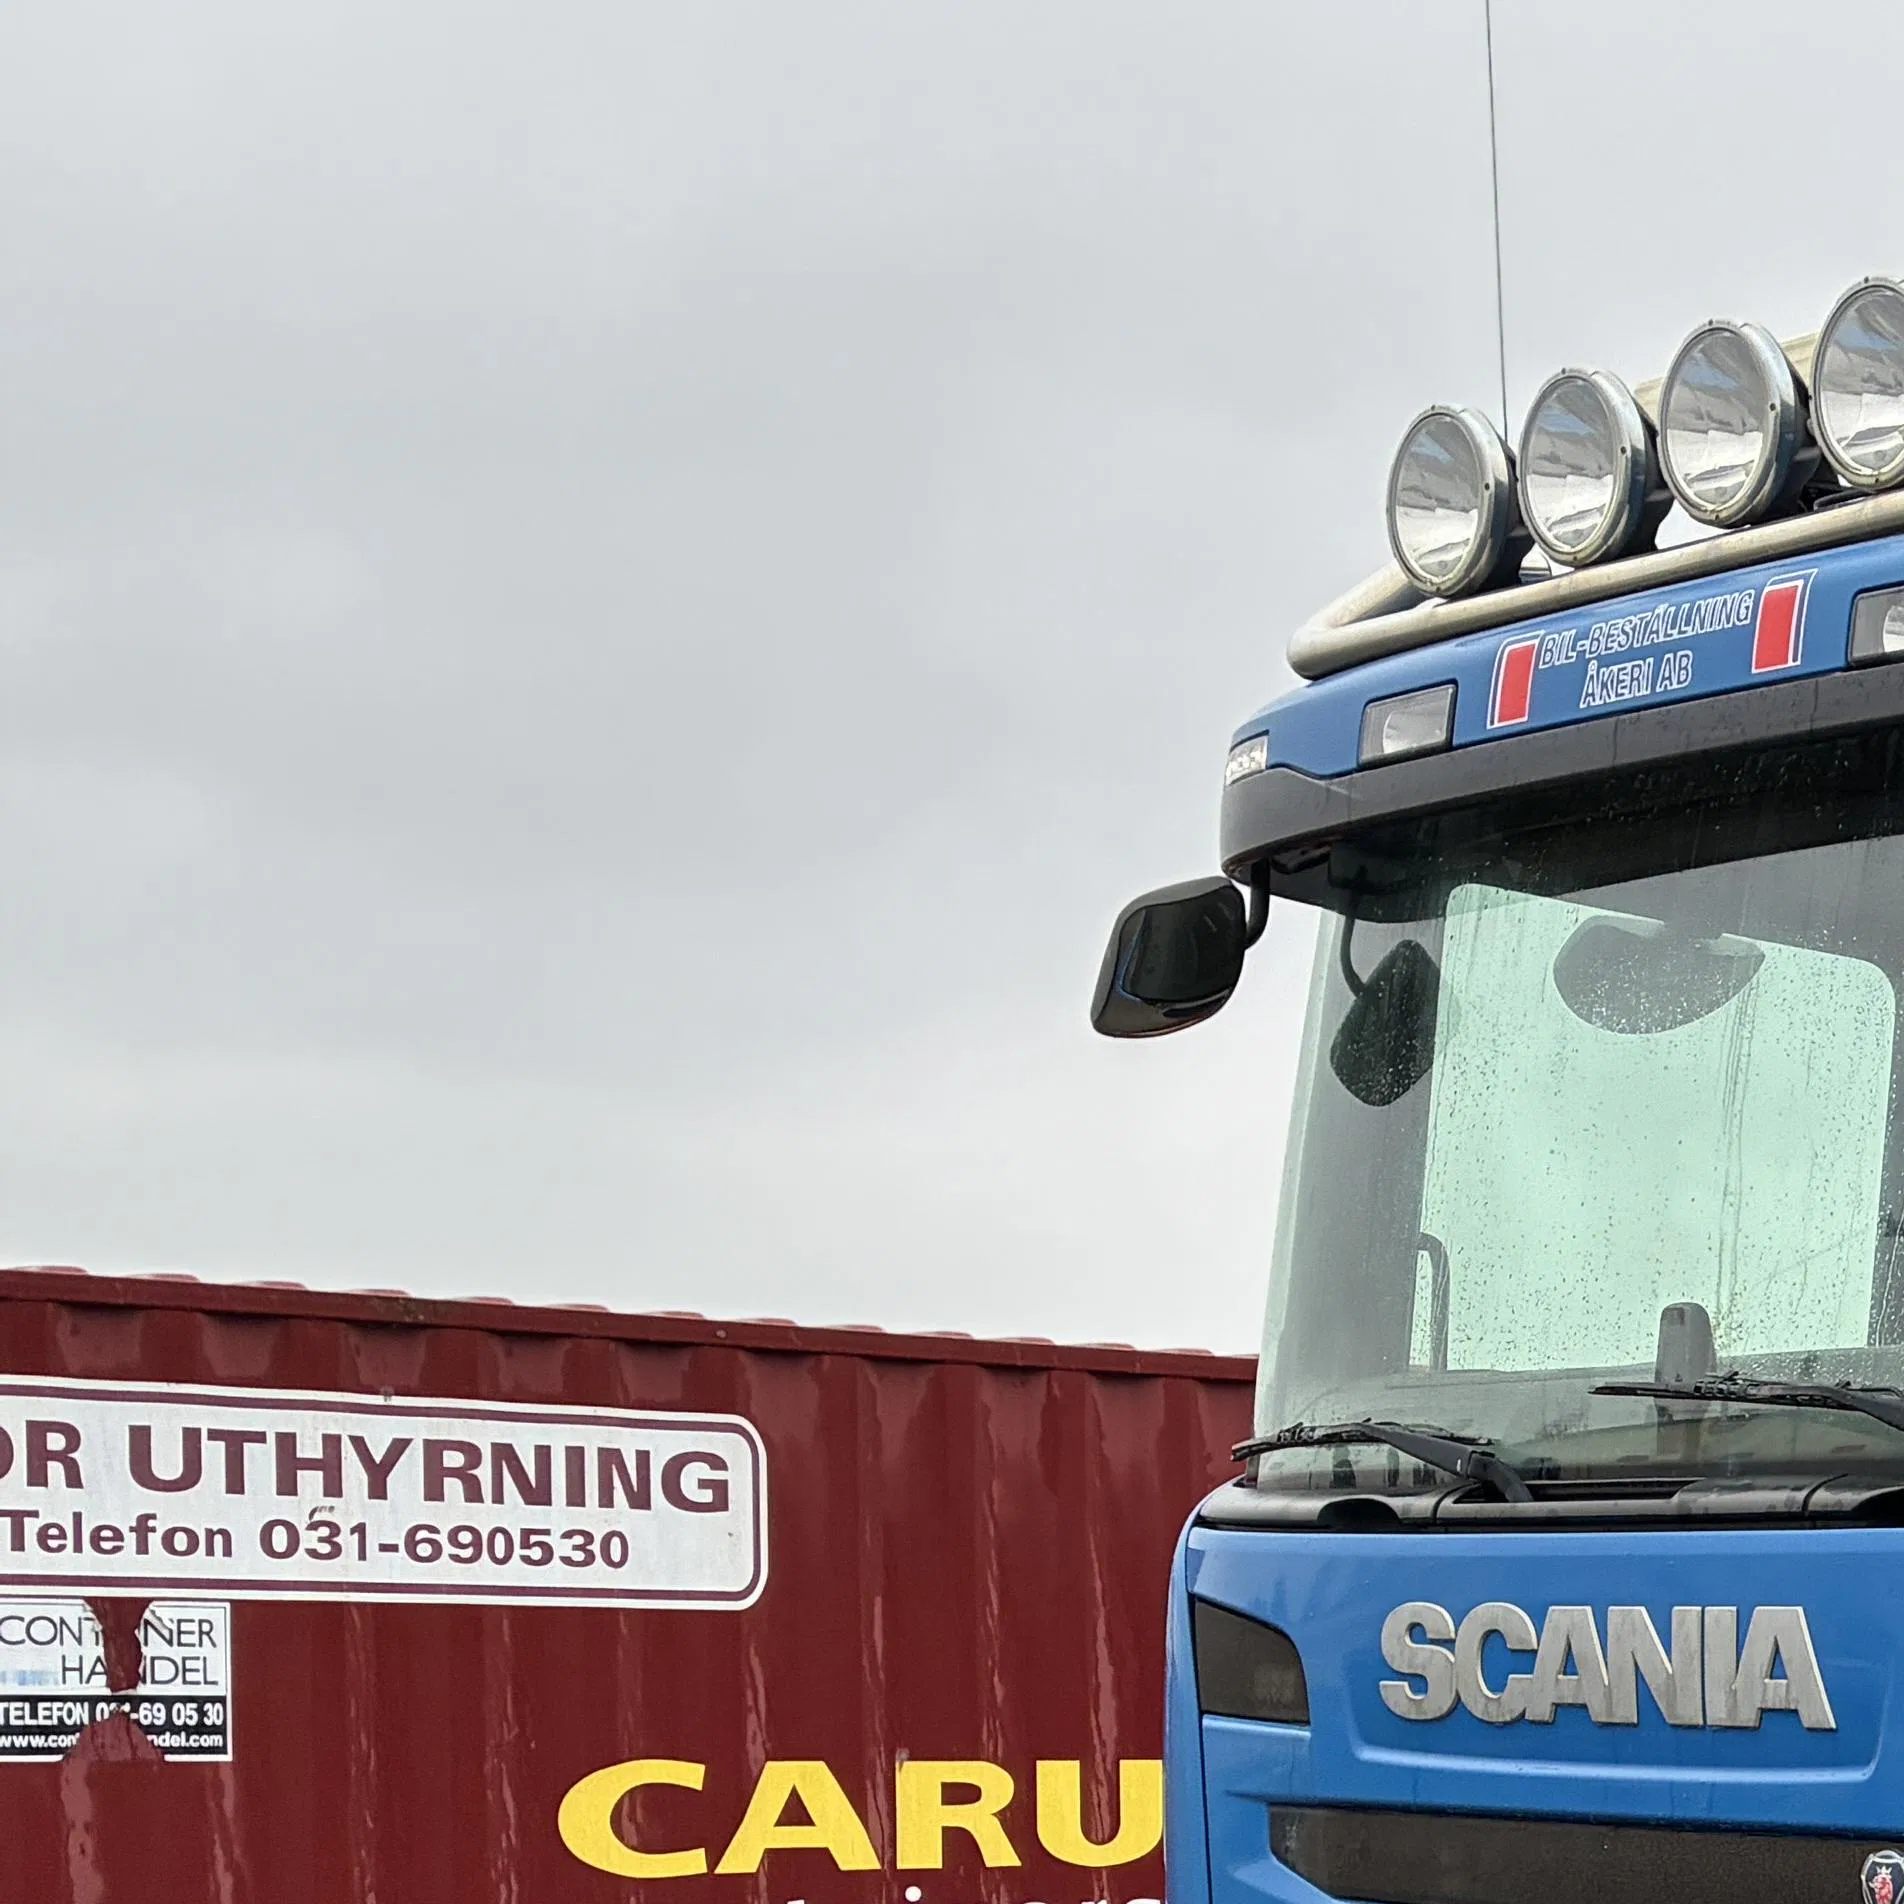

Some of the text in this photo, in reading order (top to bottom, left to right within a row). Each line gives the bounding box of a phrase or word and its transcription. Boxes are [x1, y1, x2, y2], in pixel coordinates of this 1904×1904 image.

[1539, 589, 1755, 669] BIL-BESTÄLLNING
[1579, 650, 1692, 708] ÅKERI AB
[0, 1420, 730, 1513] R UTHYRNING
[0, 1509, 630, 1569] Telefon 031-690530
[0, 1615, 217, 1648] CONTNER
[1379, 1601, 1837, 1732] SCANIA
[172, 1702, 198, 1726] 05
[203, 1702, 224, 1726] 30
[557, 1758, 1163, 1878] CARU
